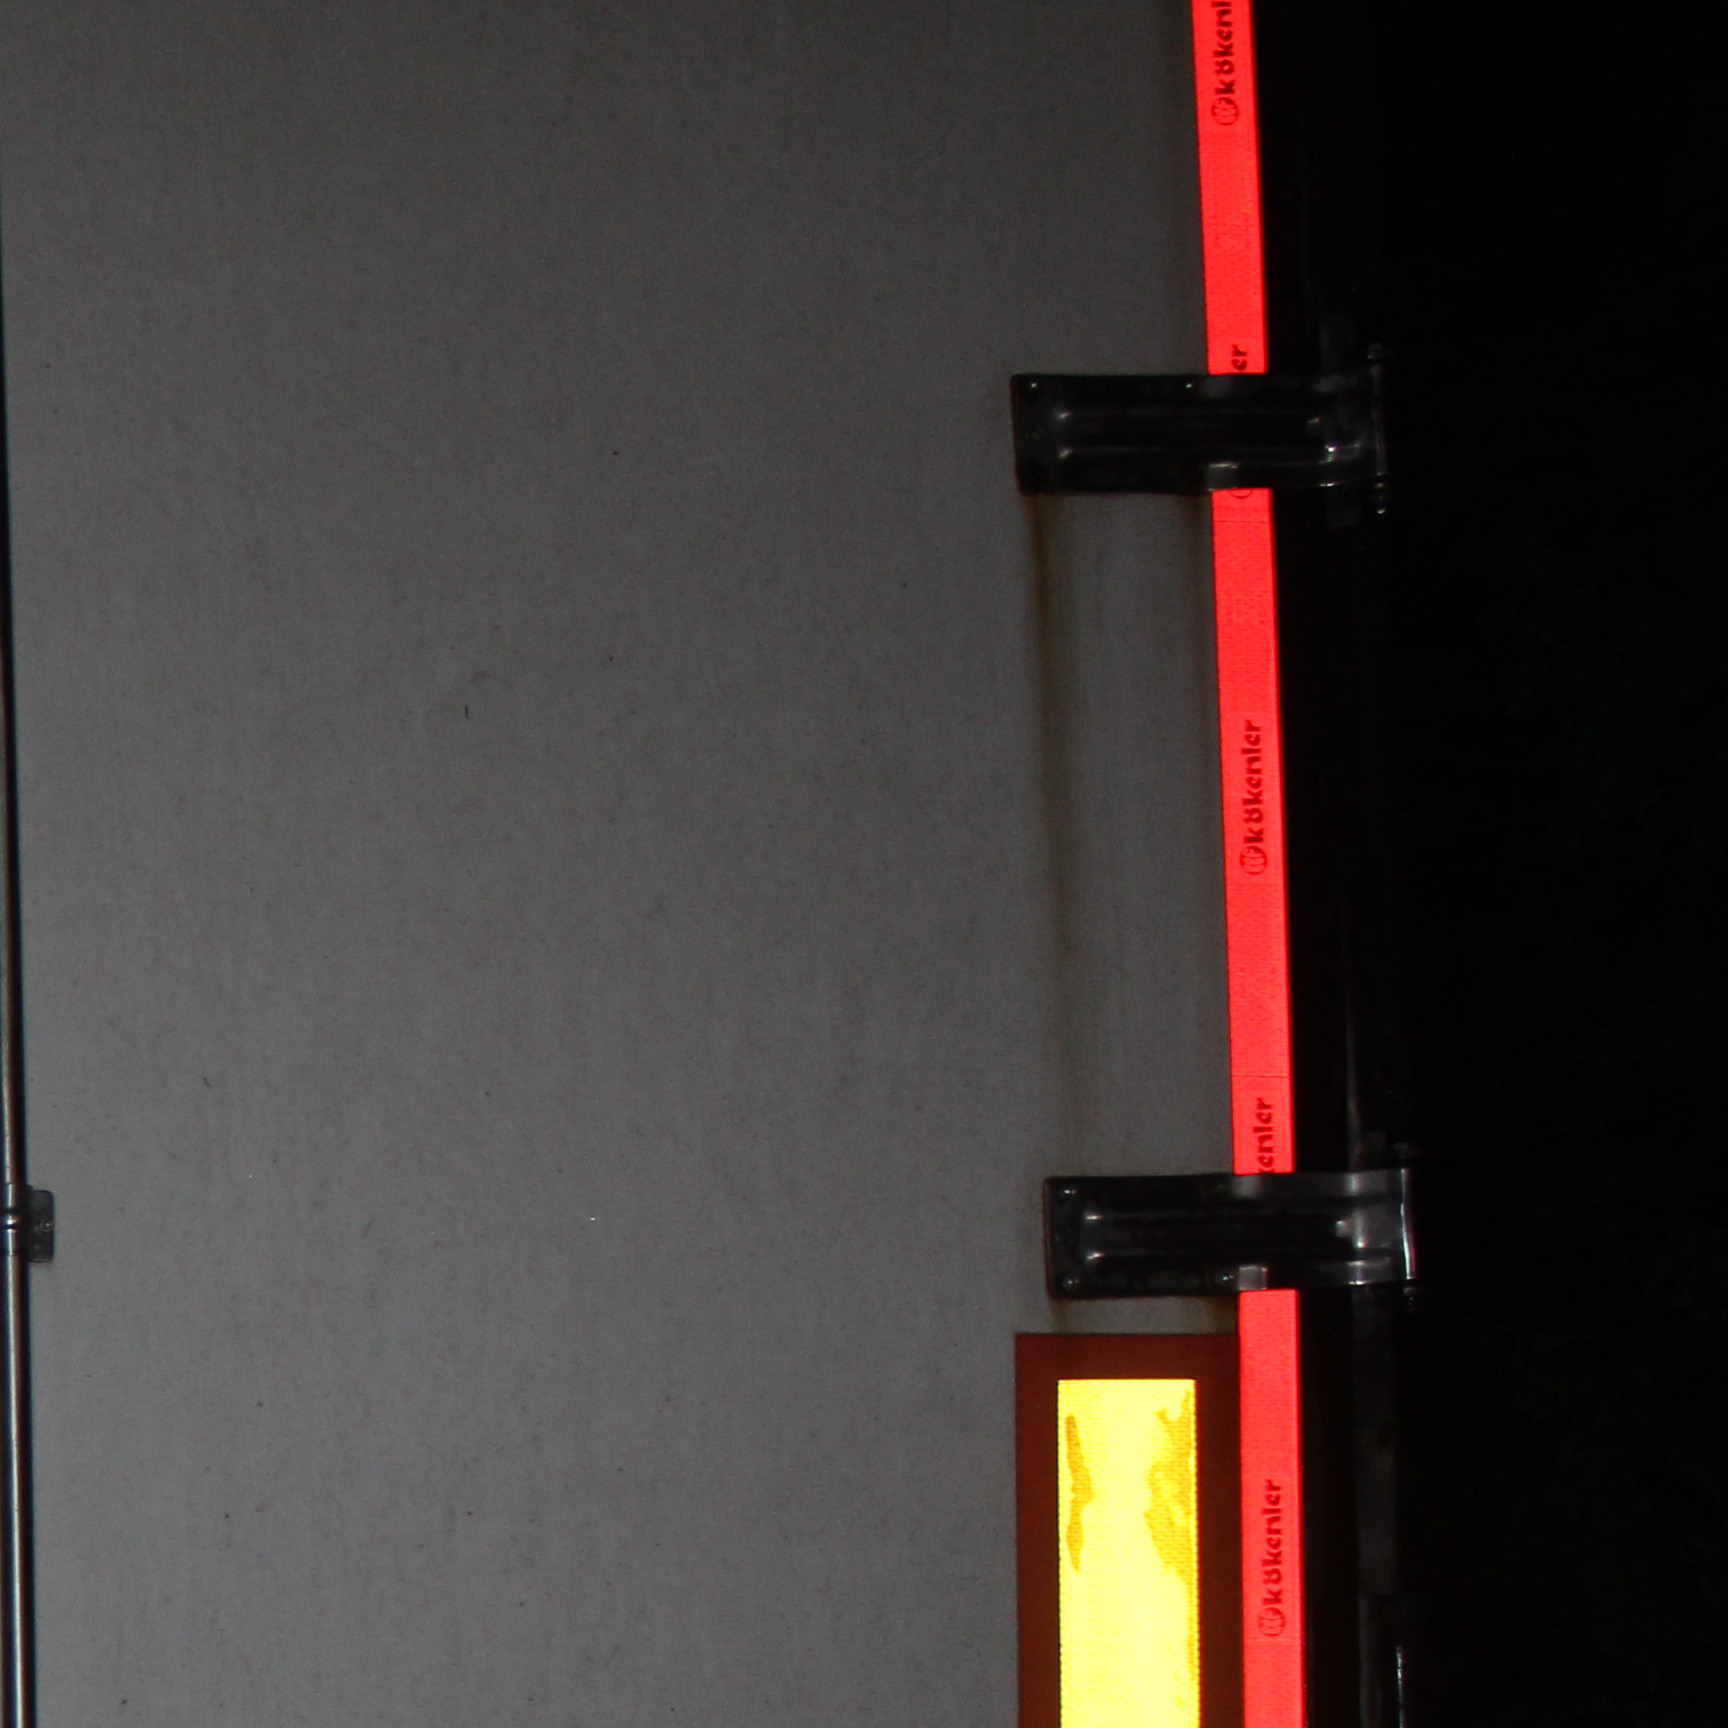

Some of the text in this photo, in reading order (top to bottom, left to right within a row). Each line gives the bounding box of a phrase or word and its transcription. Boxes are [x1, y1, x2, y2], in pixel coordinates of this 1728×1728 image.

[1212, 0, 1235, 95] kökenl
[1243, 719, 1264, 844] kökenler
[1252, 1097, 1274, 1172] enler
[1263, 1479, 1285, 1606] kökenler
